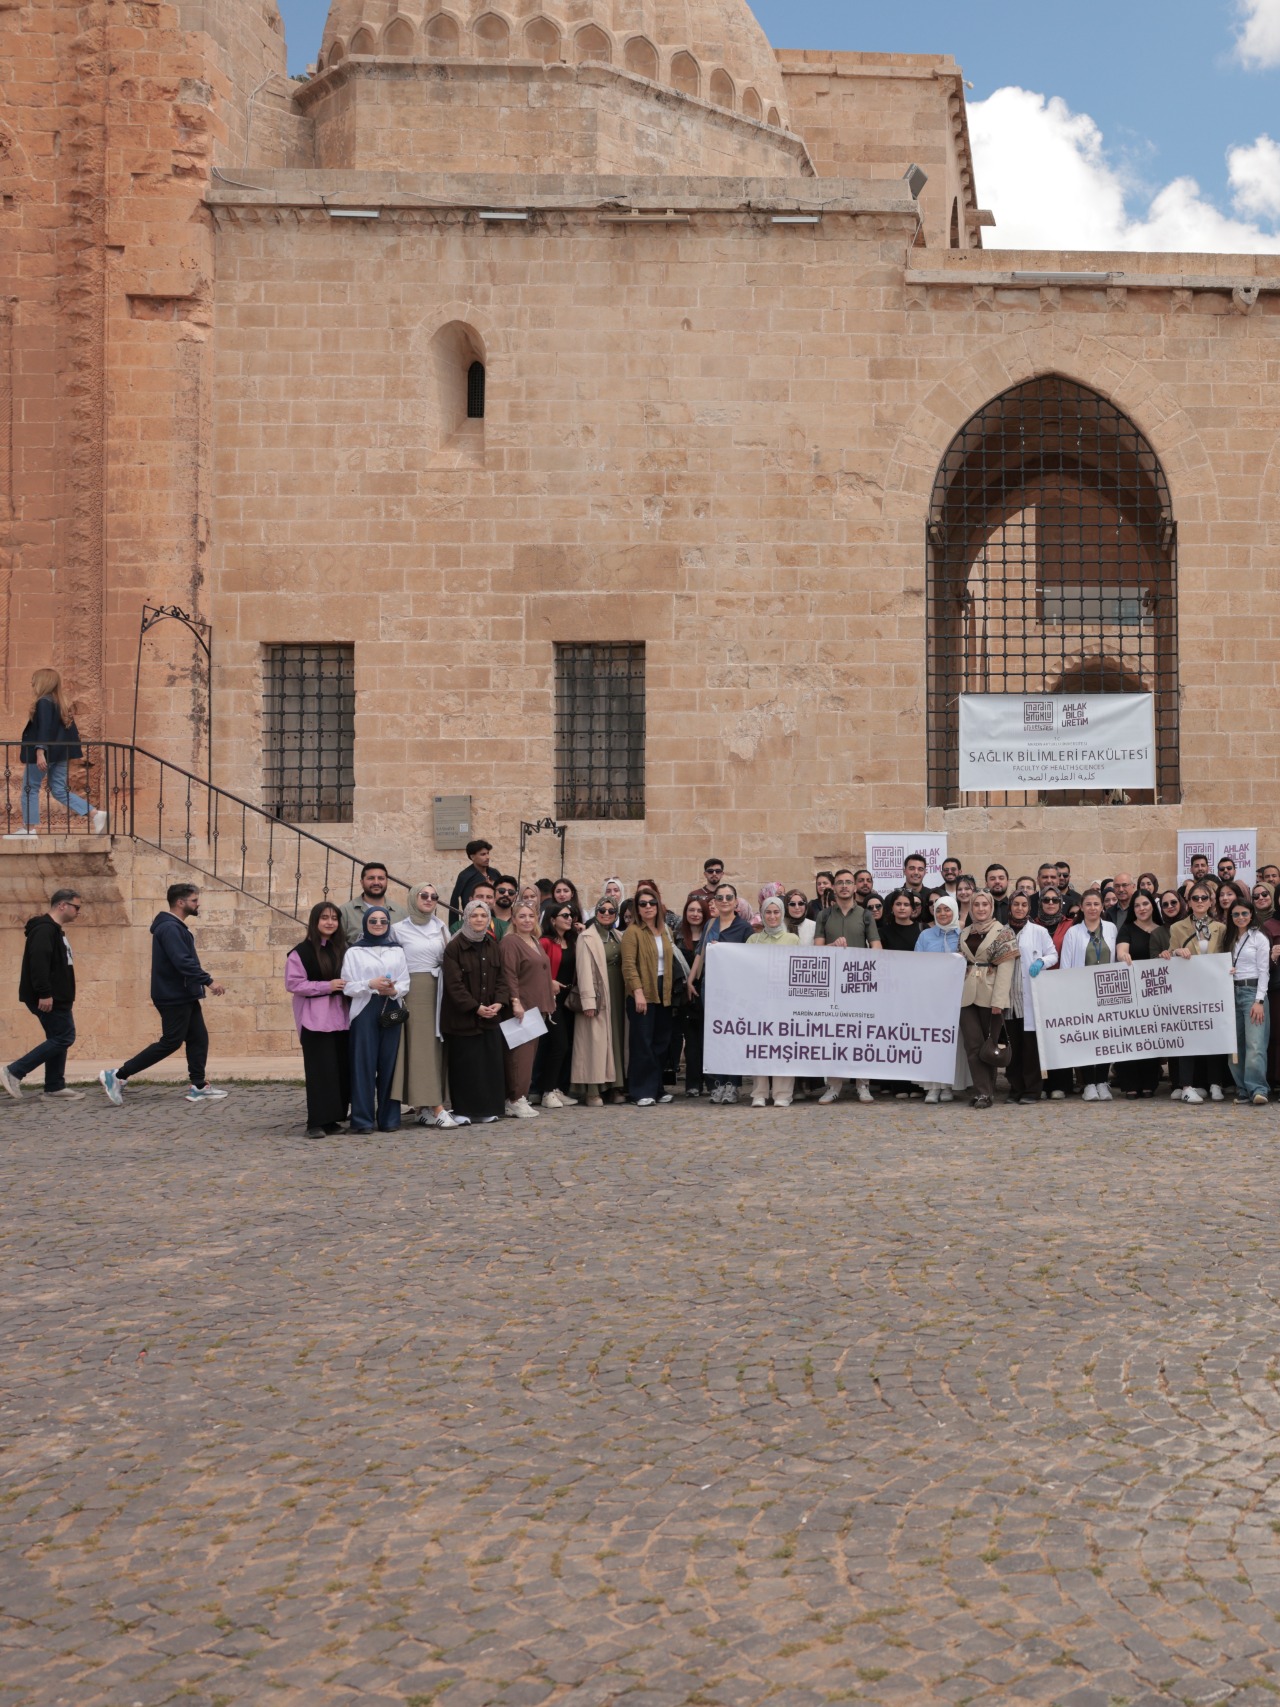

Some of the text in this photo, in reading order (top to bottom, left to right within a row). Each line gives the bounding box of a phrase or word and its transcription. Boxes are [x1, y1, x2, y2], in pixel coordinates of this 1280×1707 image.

[1062, 702, 1087, 712] AHLAK
[970, 748, 1148, 762] SAĞLIK BİLİMLERİ FAKÜLTESİ
[1048, 772, 1075, 782] العلوم
[1078, 772, 1095, 780] كلية
[1224, 843, 1249, 853] AHLAK
[842, 960, 876, 972] AHLAK
[847, 971, 871, 982] BİLGİ
[1141, 966, 1169, 979] AHLAK
[841, 982, 878, 994] ÜRETİM
[1146, 976, 1167, 988] BİLGİ
[1046, 1000, 1224, 1028] MARDİN ARTUKLU ÜNİVERSİTESİ
[713, 1018, 955, 1044] SAĞLIK BİLİMLERİ FAKÜLTESİ
[1059, 1018, 1214, 1044] SAĞLIK BİLİMLERİ FAKÜLTESİ
[1095, 1037, 1185, 1056] EBELİK BÖLÜMÜ
[746, 1042, 923, 1064] HEMŞİRELİK BÖLÜMÜ
